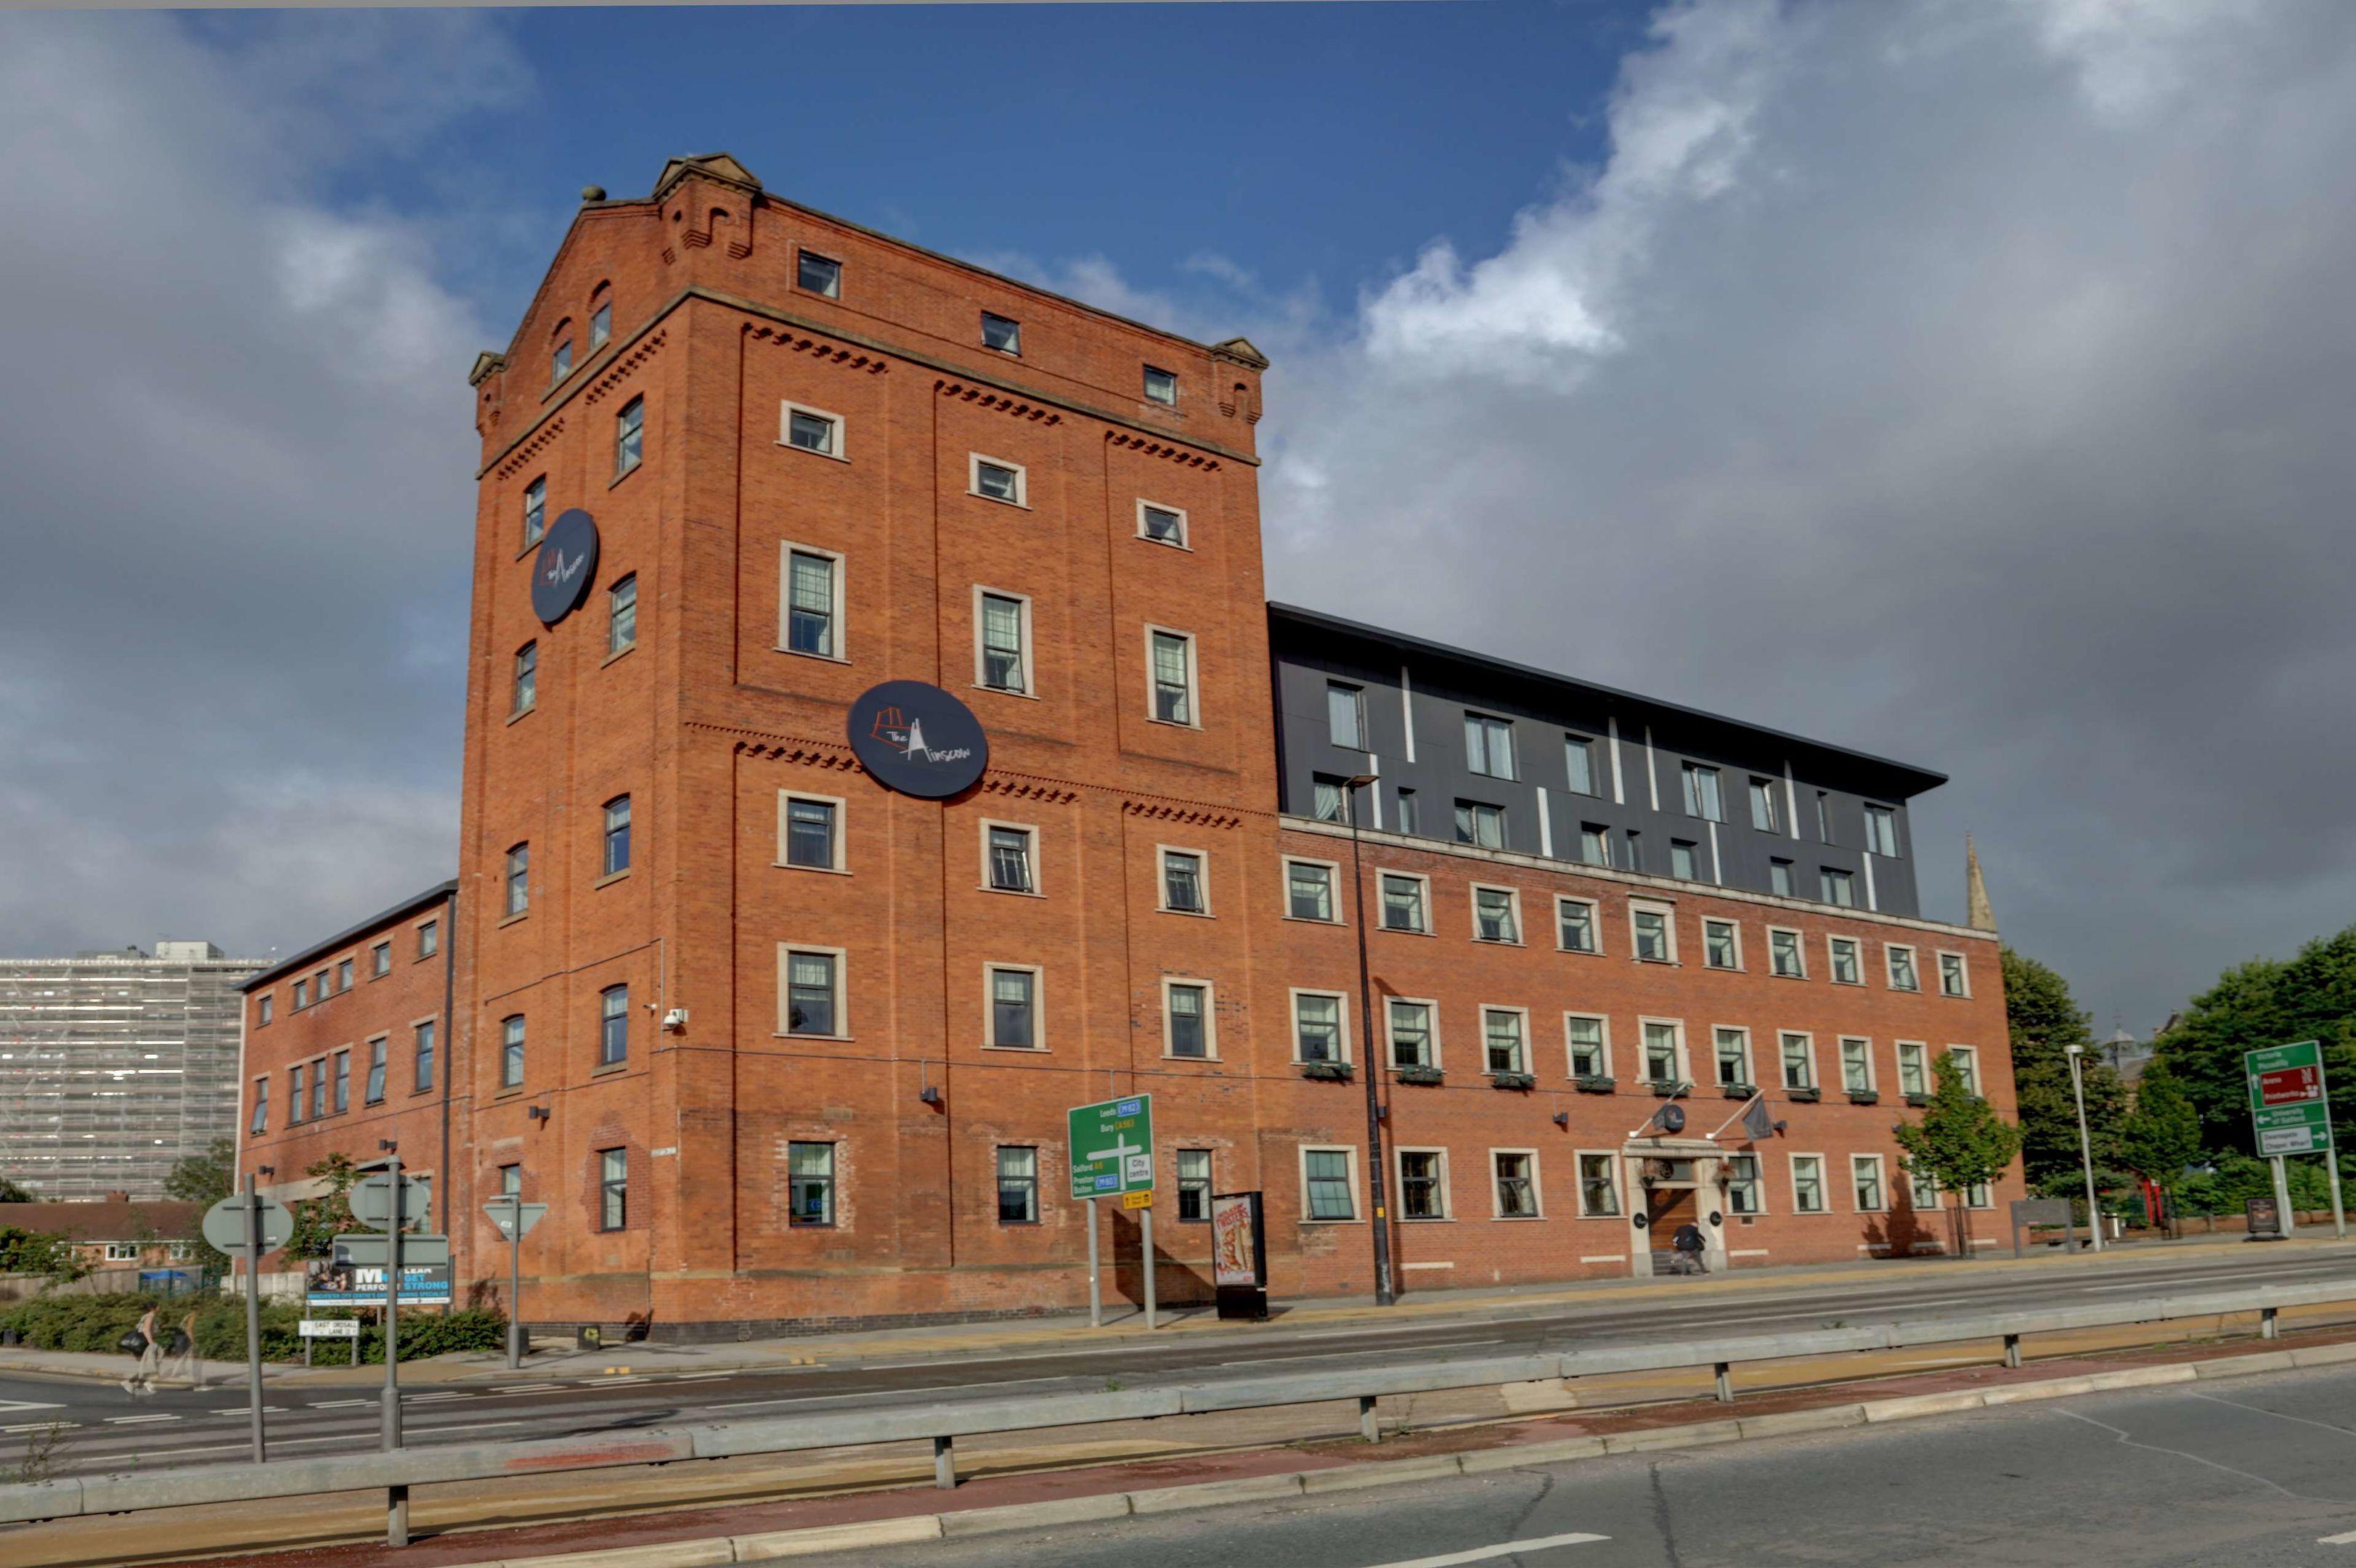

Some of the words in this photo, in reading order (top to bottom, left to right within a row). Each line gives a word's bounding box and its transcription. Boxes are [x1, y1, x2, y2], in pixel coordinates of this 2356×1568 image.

[886, 731, 908, 742] The
[1100, 1107, 1117, 1117] Leeds
[1101, 1124, 1114, 1133] Bury
[1073, 1163, 1093, 1173] Salford
[1131, 1159, 1145, 1168] City
[404, 1274, 425, 1283] GET
[404, 1282, 448, 1291] STRONG
